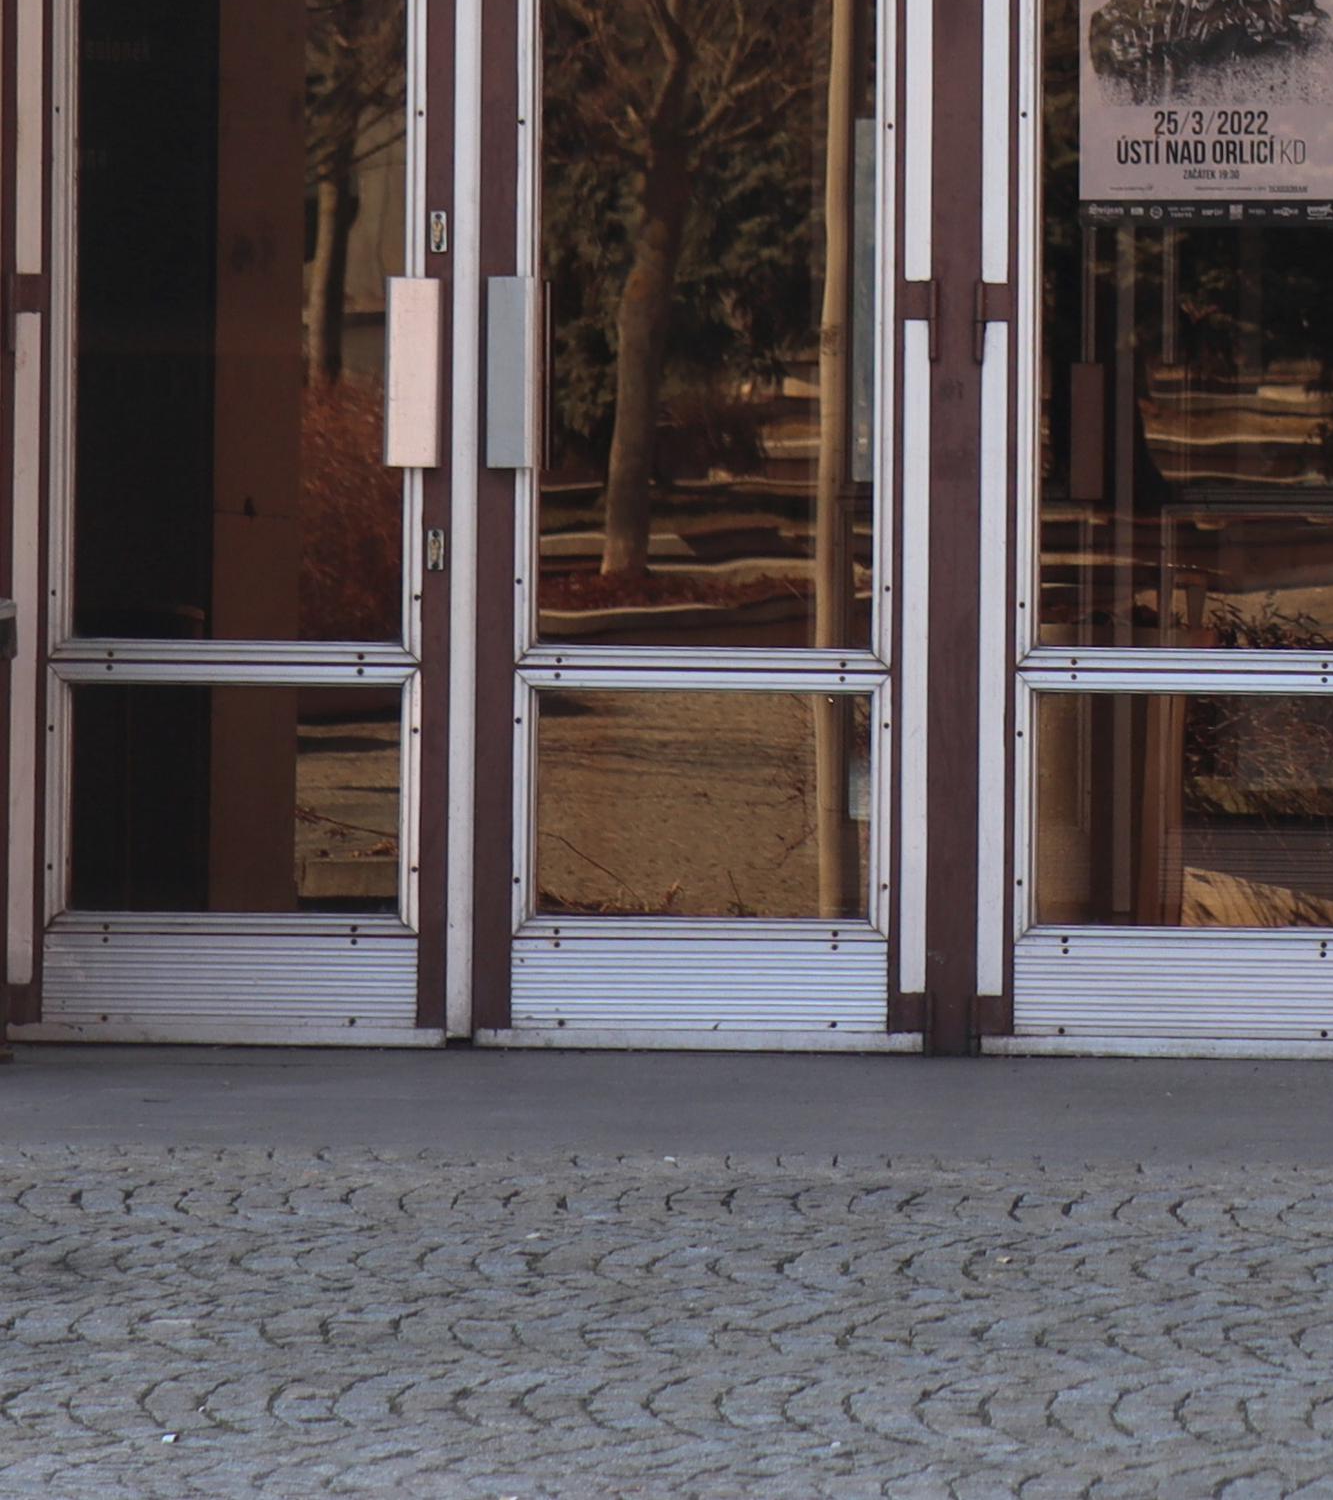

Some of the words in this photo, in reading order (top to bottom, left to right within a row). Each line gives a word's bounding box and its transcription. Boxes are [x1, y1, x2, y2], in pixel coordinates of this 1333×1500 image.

[1116, 135, 1160, 165] ÚSTÍ
[1165, 140, 1206, 165] NAD
[1212, 135, 1275, 165] ORLICÍ
[1280, 140, 1306, 165] KD
